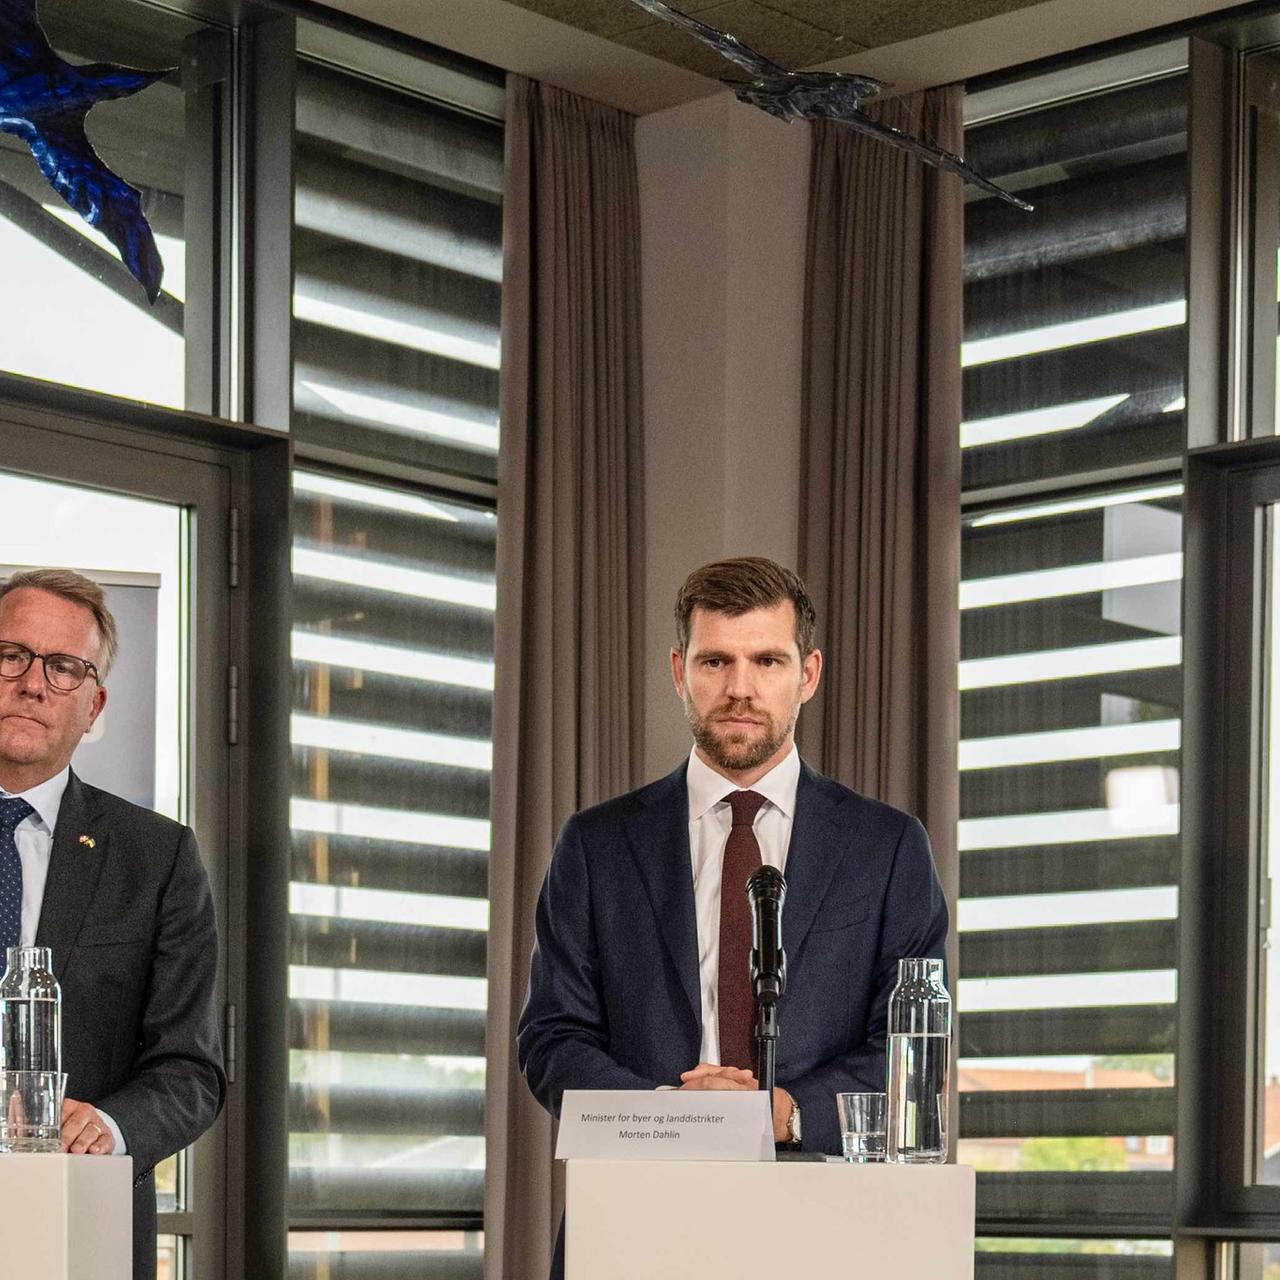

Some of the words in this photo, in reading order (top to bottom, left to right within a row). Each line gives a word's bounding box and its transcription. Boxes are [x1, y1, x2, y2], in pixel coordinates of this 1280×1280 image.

[581, 1113, 616, 1122] Minister
[618, 1113, 630, 1122] for
[632, 1113, 652, 1124] byer
[653, 1115, 665, 1124] og
[666, 1114, 724, 1123] landdistrikter
[618, 1130, 651, 1139] Morten
[652, 1130, 680, 1139] Dahlin
